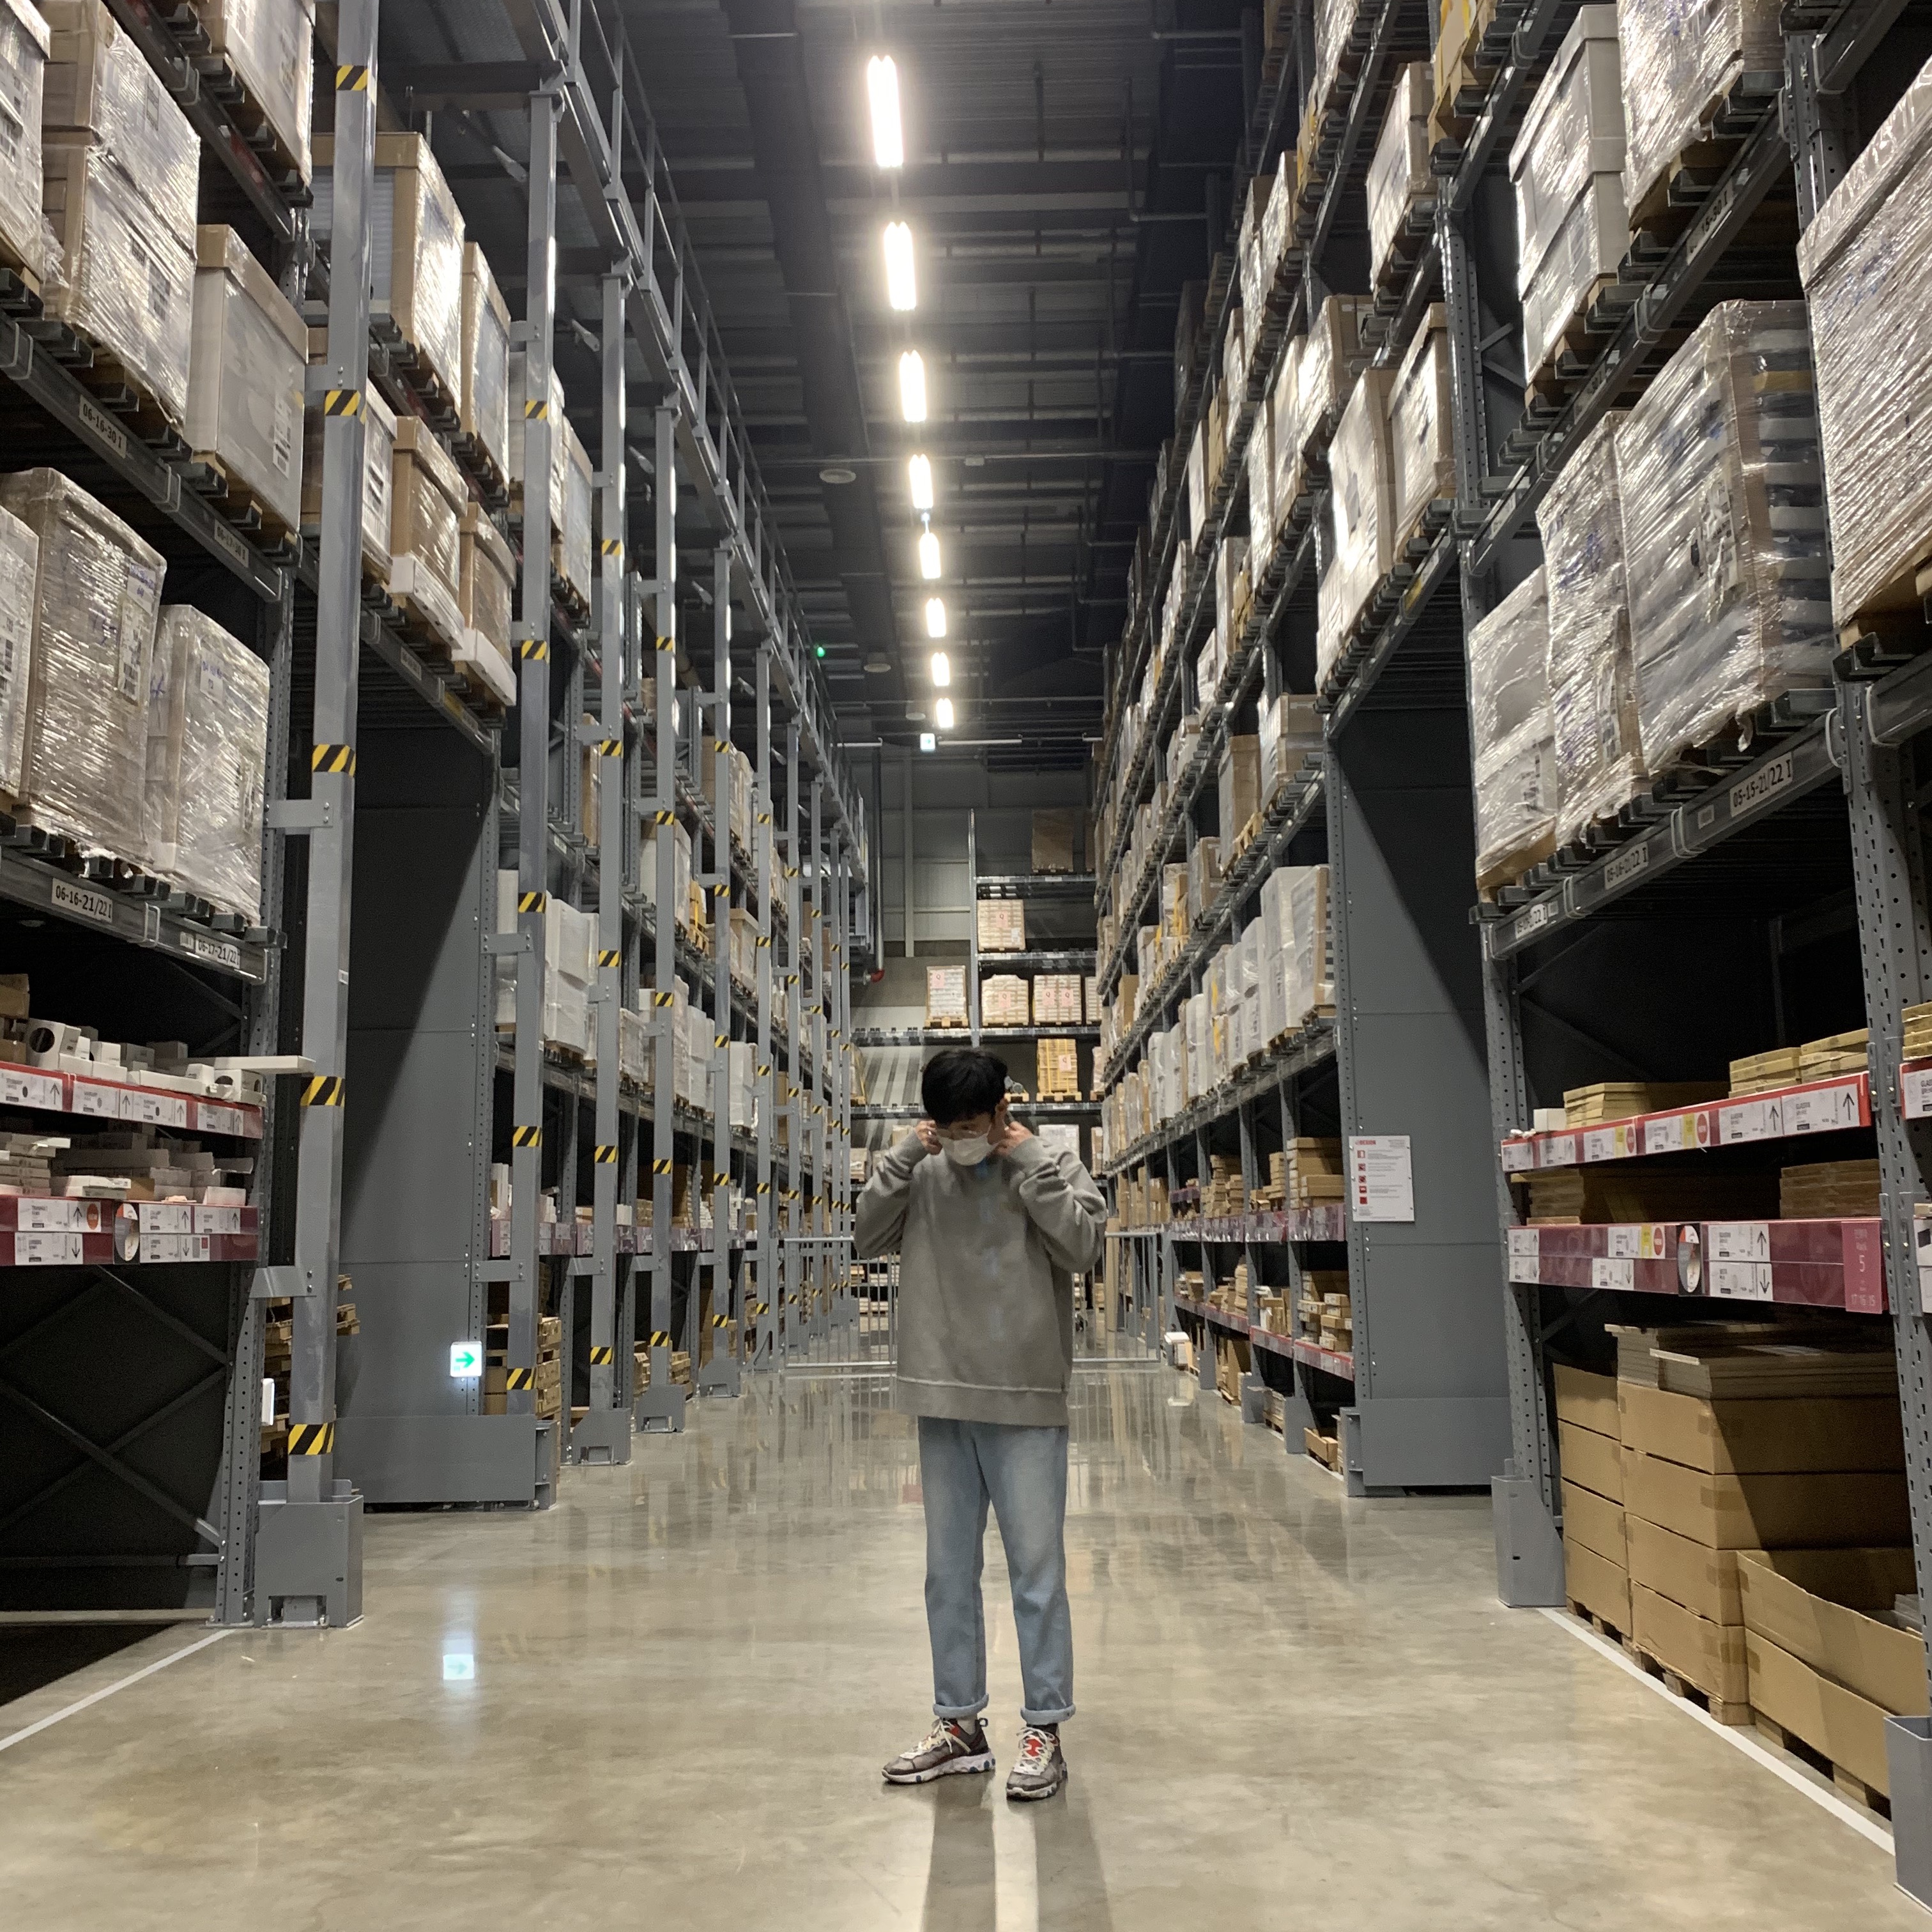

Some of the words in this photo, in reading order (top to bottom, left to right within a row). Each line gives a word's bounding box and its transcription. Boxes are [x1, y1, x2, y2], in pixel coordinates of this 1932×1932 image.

[83, 403, 117, 443] 06-16-30
[56, 885, 107, 916] 06-16-21/22
[1859, 1255, 1865, 1273] 5
